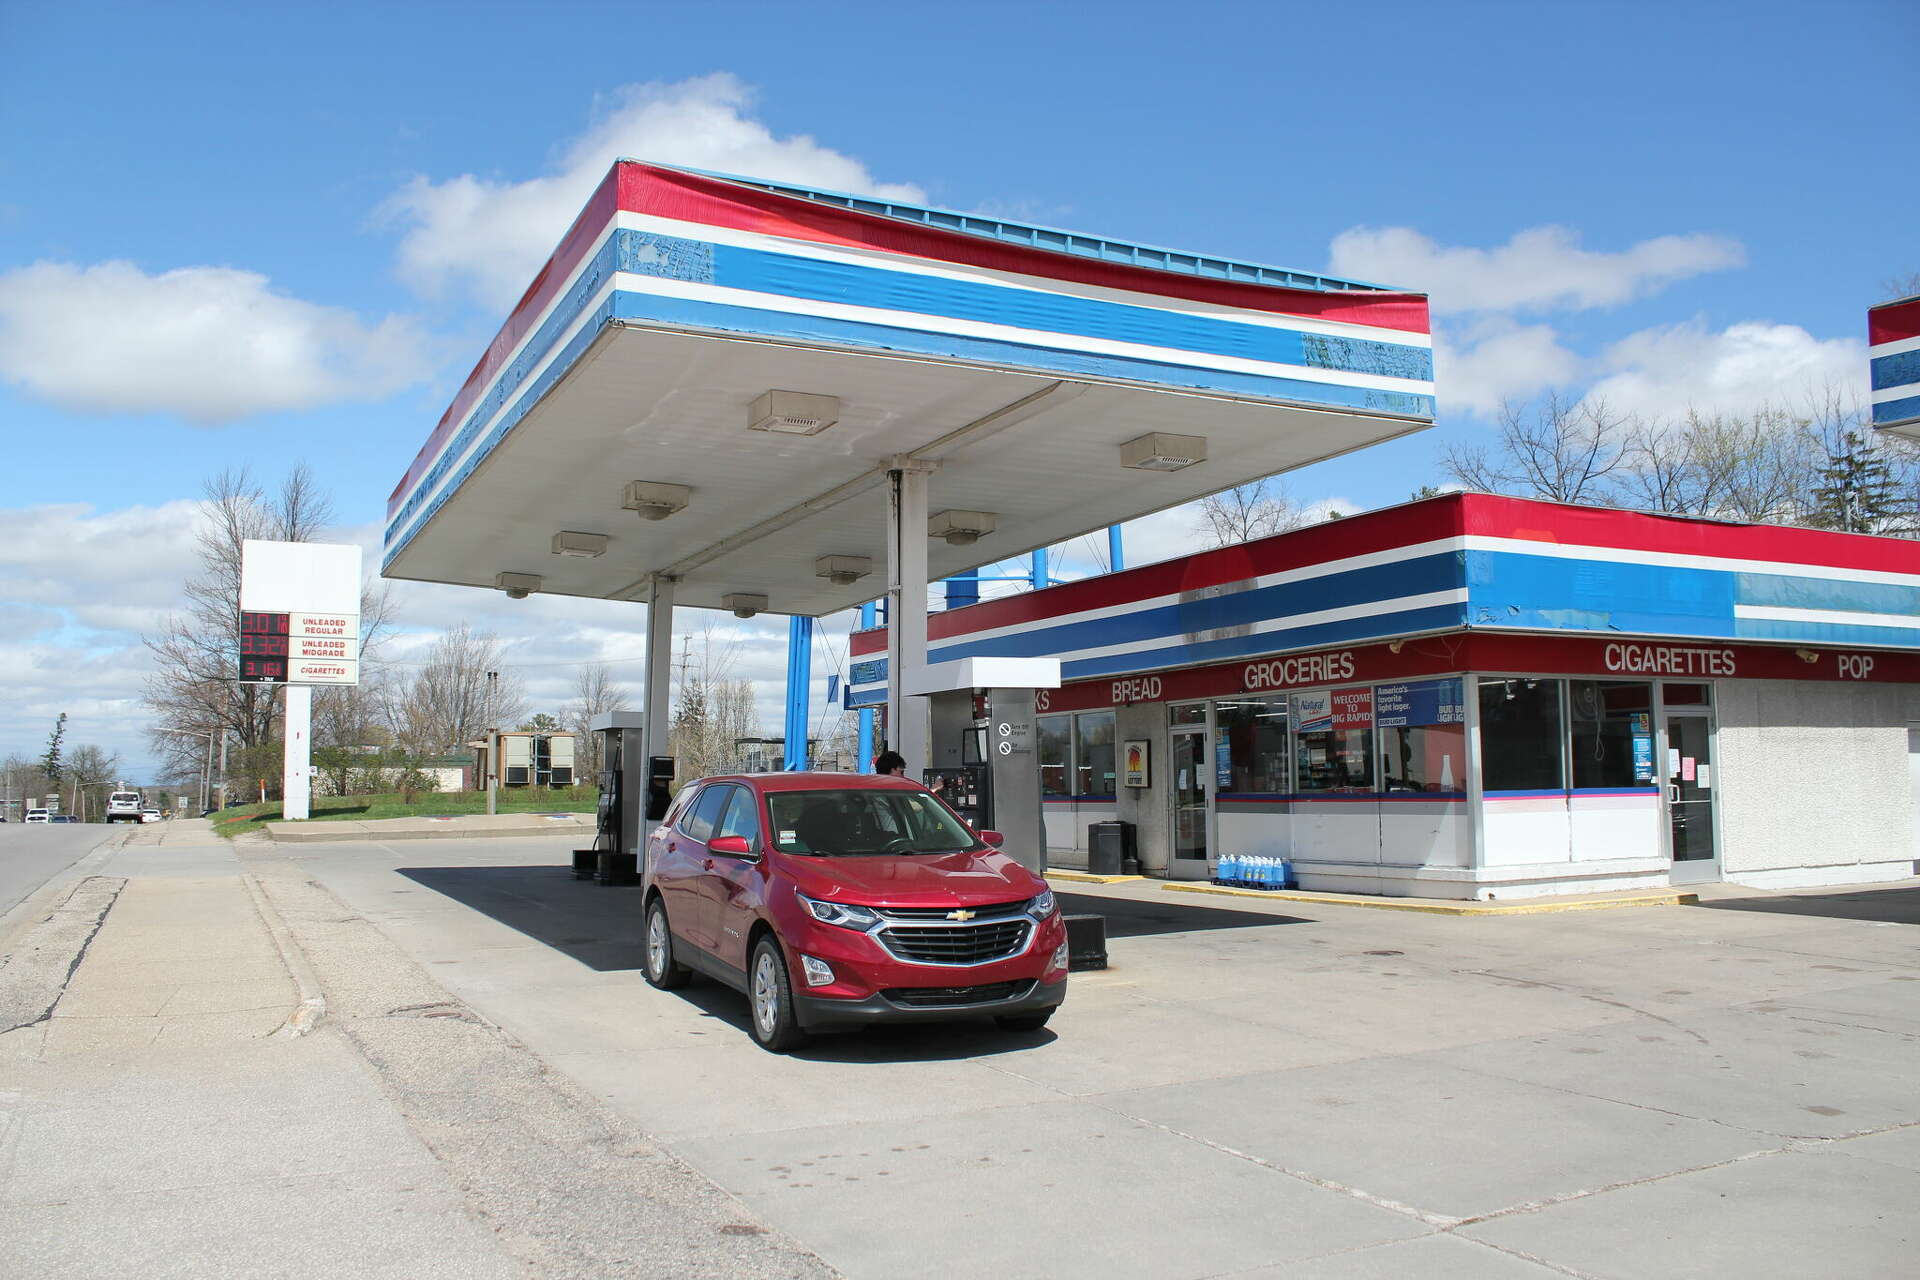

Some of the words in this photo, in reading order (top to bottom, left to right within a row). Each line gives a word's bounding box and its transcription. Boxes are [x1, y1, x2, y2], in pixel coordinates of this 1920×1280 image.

[303, 618, 346, 626] UNLEADED
[305, 627, 343, 635] REGULAR
[302, 640, 345, 649] UNLEADED
[302, 649, 345, 657] MIDGRADE
[1604, 642, 1737, 676] CIGARETTES
[300, 667, 346, 675] CIGARETTES
[1244, 652, 1355, 689] GROCERIES
[1838, 655, 1874, 680] POP
[1112, 677, 1162, 703] BREAD
[1377, 685, 1408, 695] America's
[1333, 693, 1371, 705] WELCOME
[1378, 694, 1402, 703] favorite
[1346, 704, 1359, 713] TO
[1378, 704, 1392, 714] light
[1393, 703, 1411, 712] lager.
[1438, 705, 1454, 713] BUD
[1331, 714, 1346, 723] BIG
[1347, 712, 1374, 722] RAPIDS
